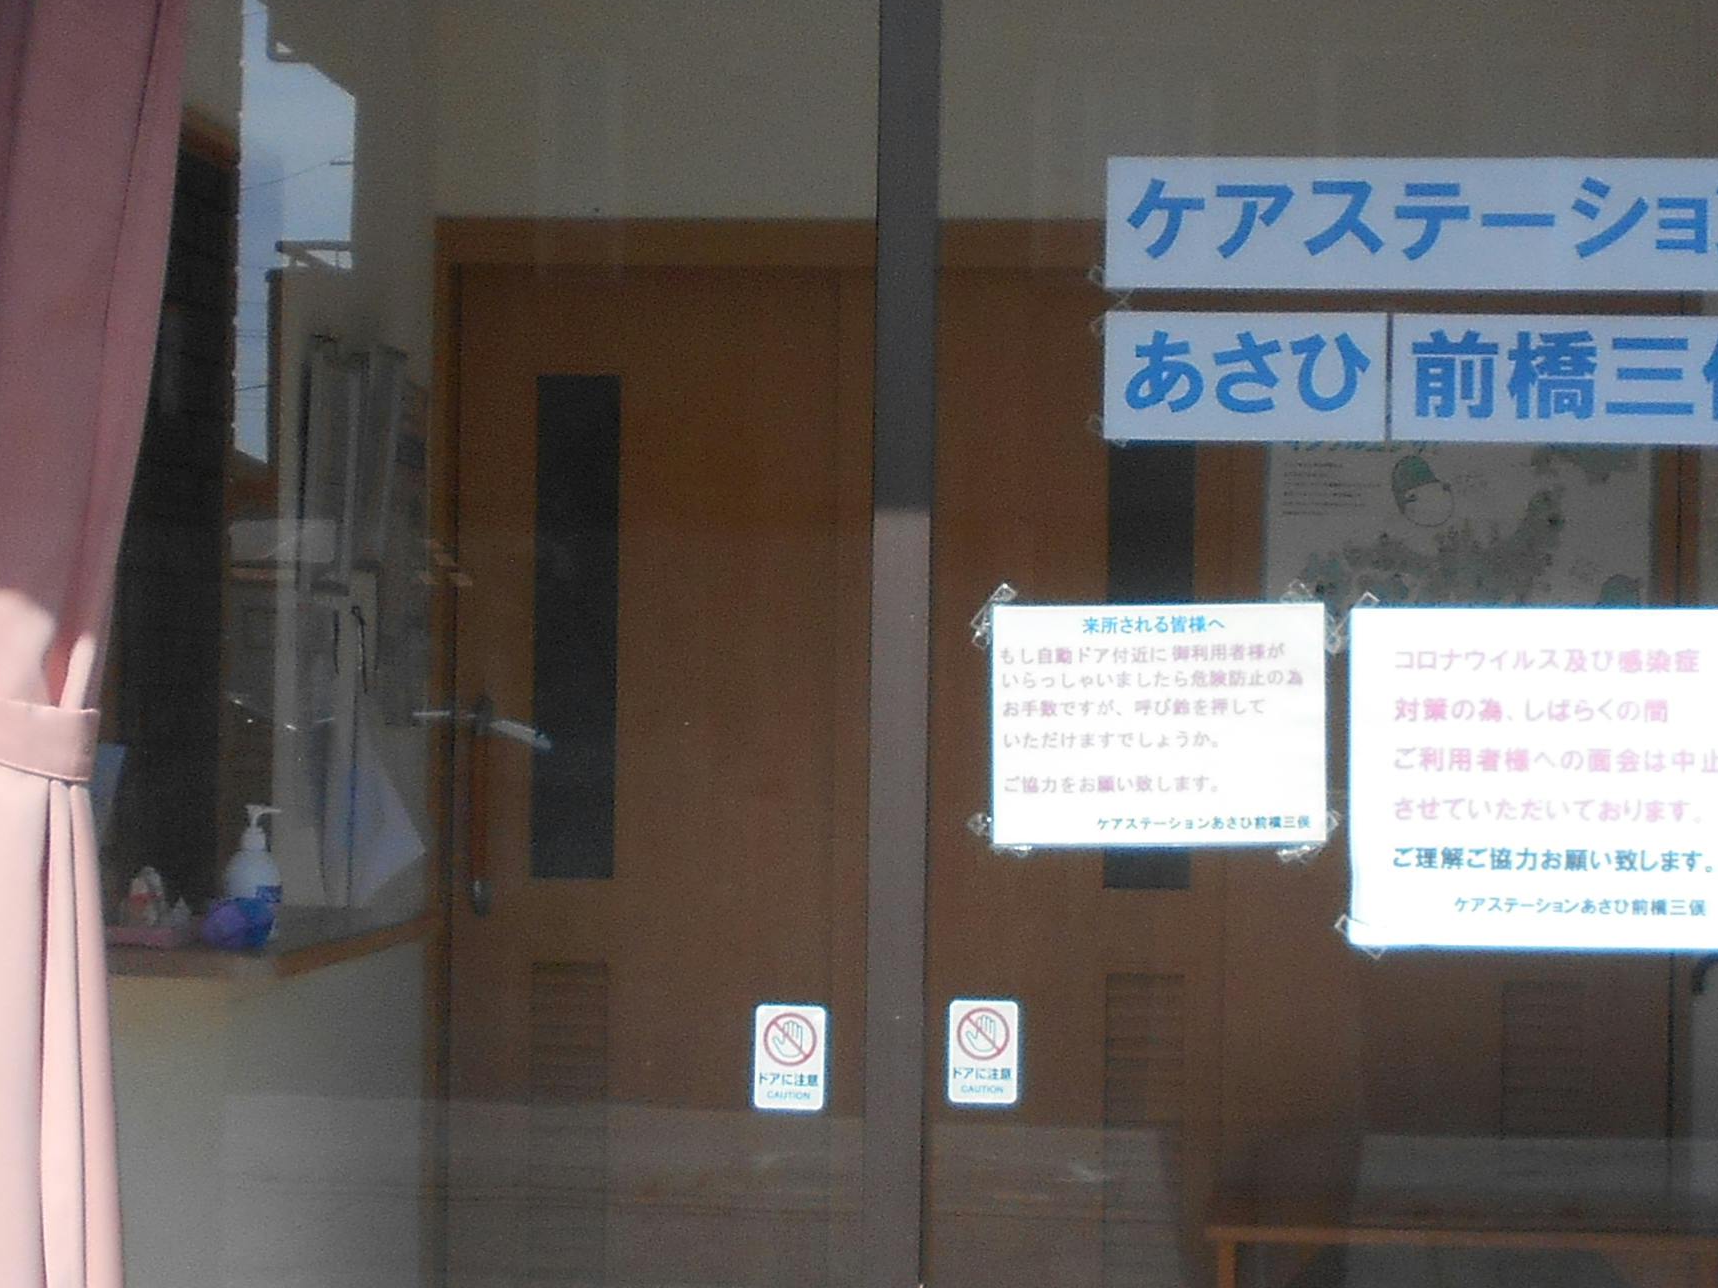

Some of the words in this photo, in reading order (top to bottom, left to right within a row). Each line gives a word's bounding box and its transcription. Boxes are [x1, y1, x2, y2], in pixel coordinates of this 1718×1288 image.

[1124, 329, 1373, 414] あさひ
[1081, 615, 1225, 635] 来所される皆様へ
[1393, 648, 1701, 674] コロナウイルス及び感染症
[1002, 669, 1304, 689] いらっしゃいましたら危険防止の為
[1003, 731, 1220, 749] いただけますでしょうか。
[1003, 775, 1220, 794] ご協力をお願い致します。
[1393, 797, 1704, 824] させていただいております。
[1097, 815, 1312, 831] ケアステーションあさひ前橋三俣
[1392, 847, 1718, 874] ご理解ご協力お願い致します。
[1454, 897, 1708, 917] ケアステーションあさひ前橋三俣
[758, 1072, 819, 1088] ドアに注意
[952, 1066, 1013, 1082] ドアに注意
[766, 1089, 811, 1101] CAUTION
[960, 1083, 1004, 1096] CAUTION
